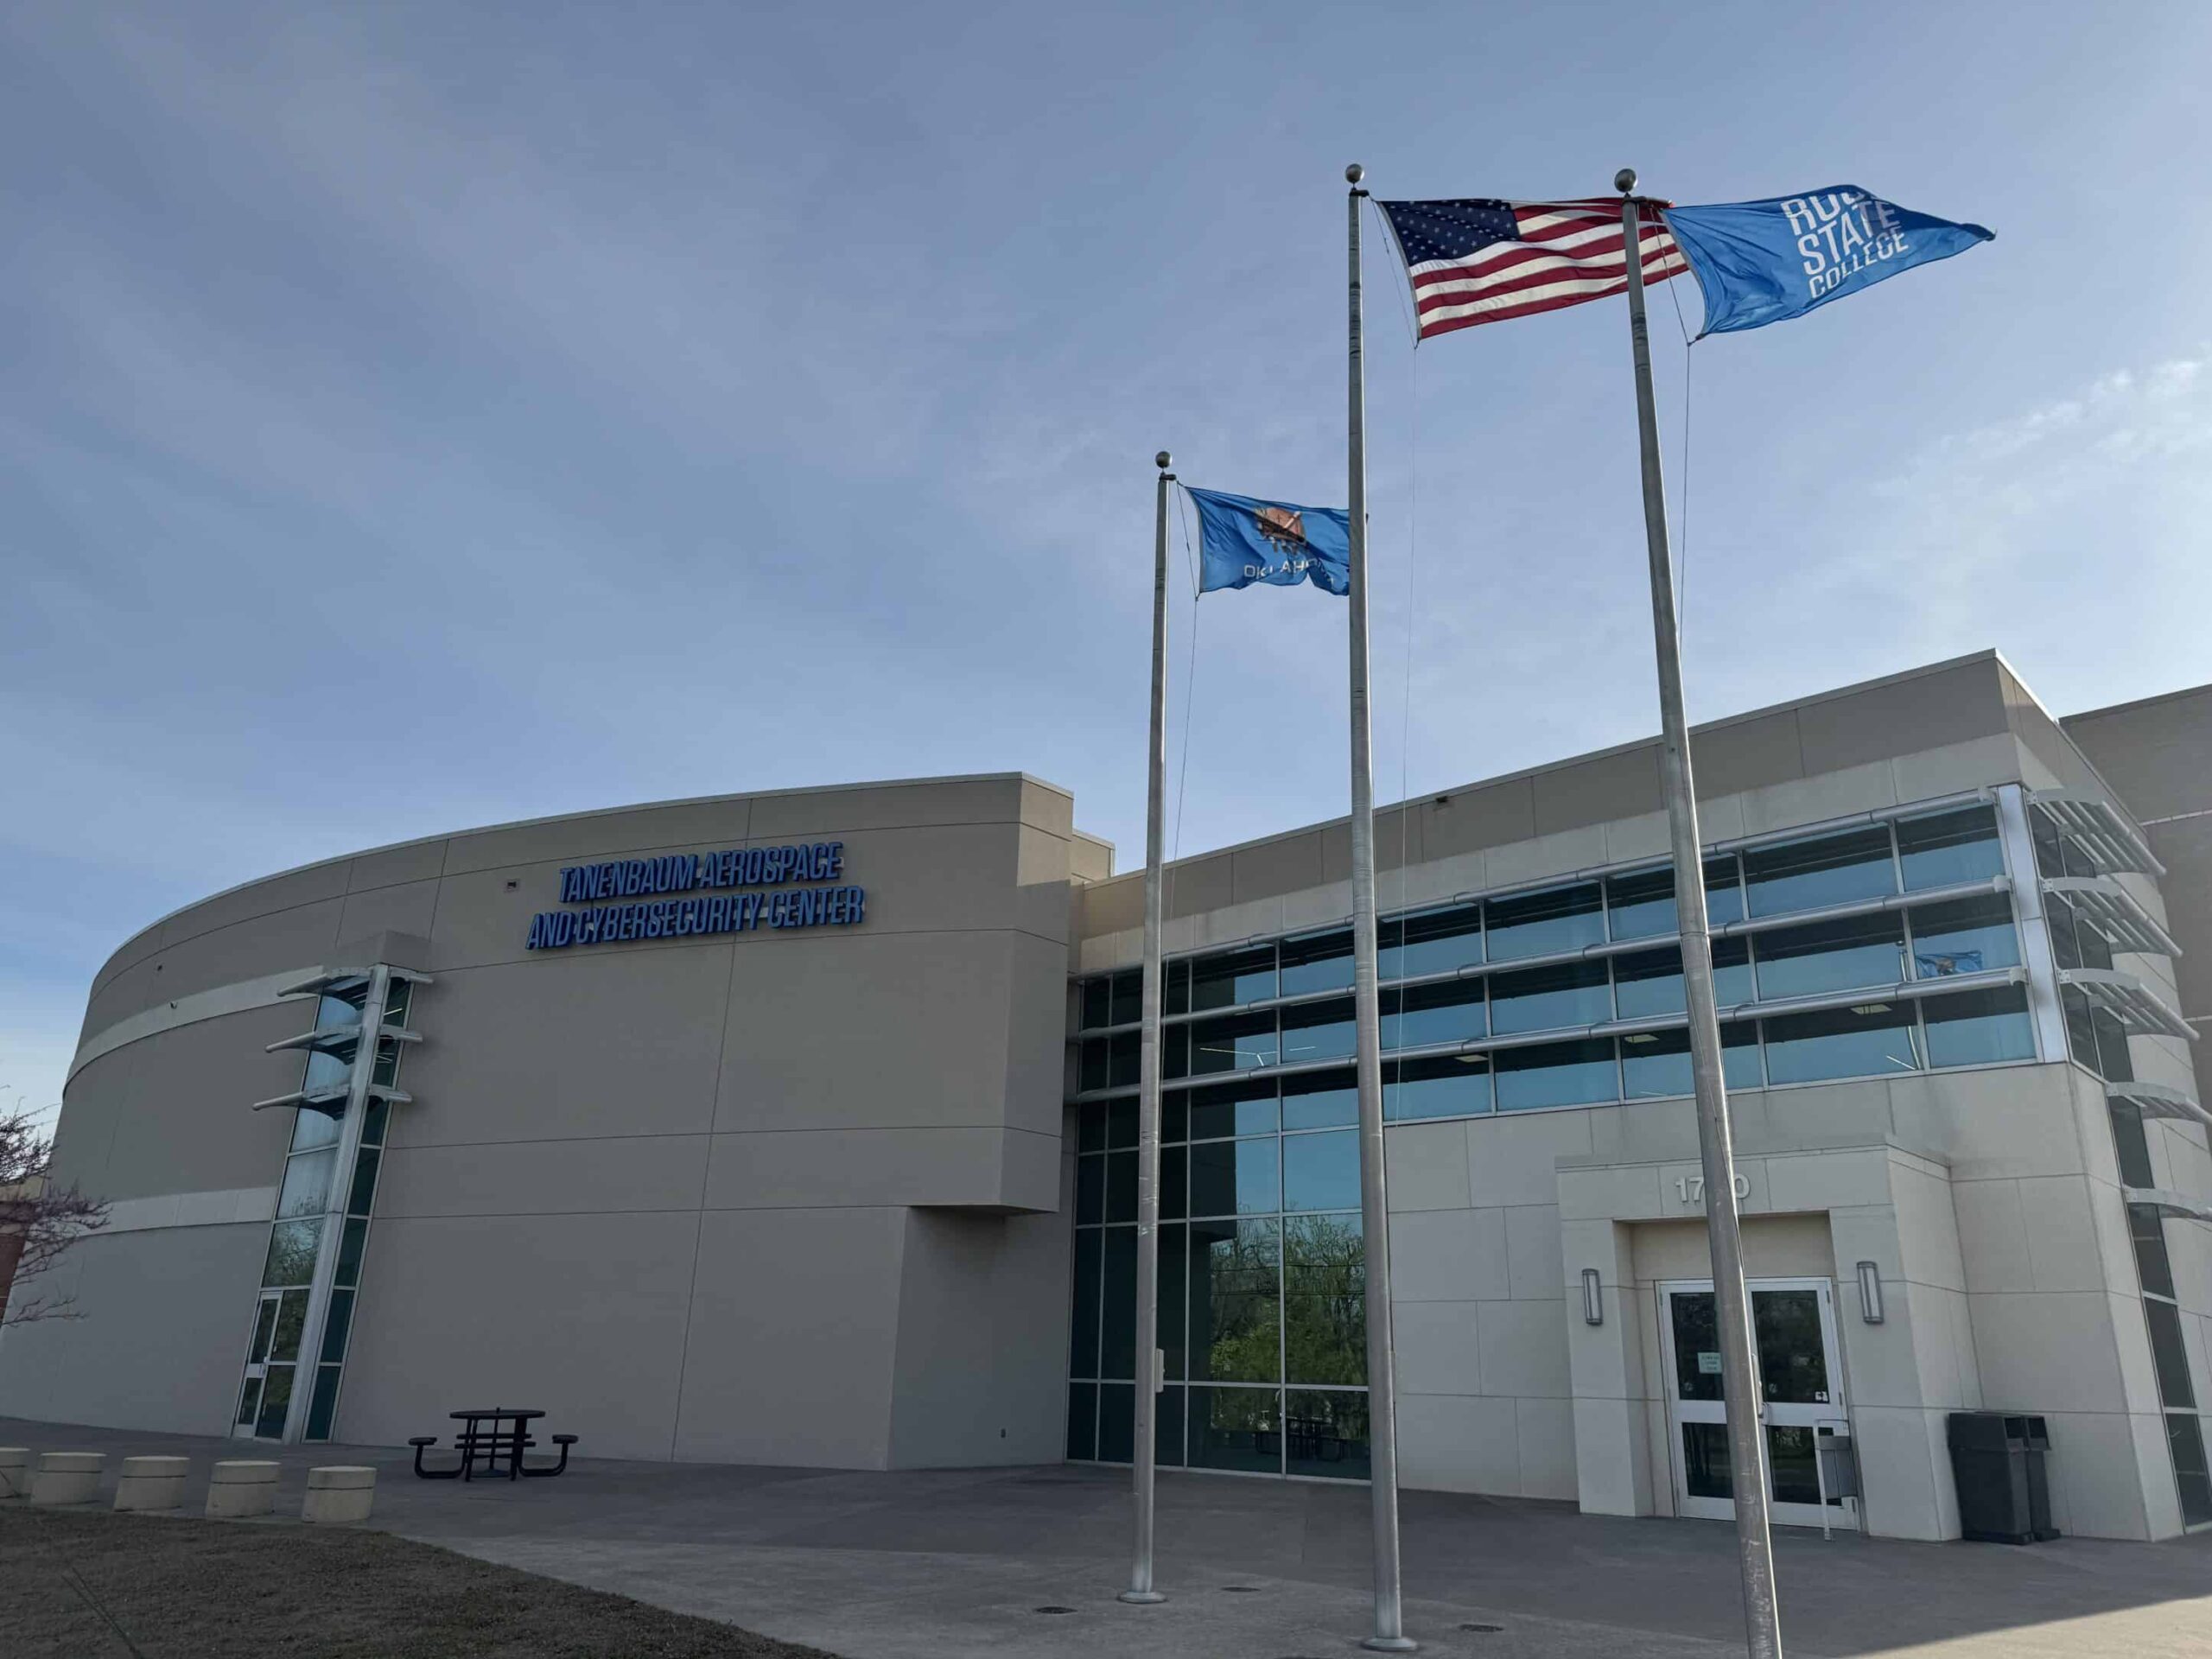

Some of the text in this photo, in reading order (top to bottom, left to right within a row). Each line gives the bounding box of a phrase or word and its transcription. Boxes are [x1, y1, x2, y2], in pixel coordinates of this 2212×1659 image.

[1796, 200, 1901, 276] STATE
[1808, 226, 1910, 299] COLLEGE
[560, 842, 843, 903] TANENBAUM AEROSPACE
[525, 886, 864, 950] AND CYBERSECURITY CENTER
[1675, 1173, 1751, 1204] 170
